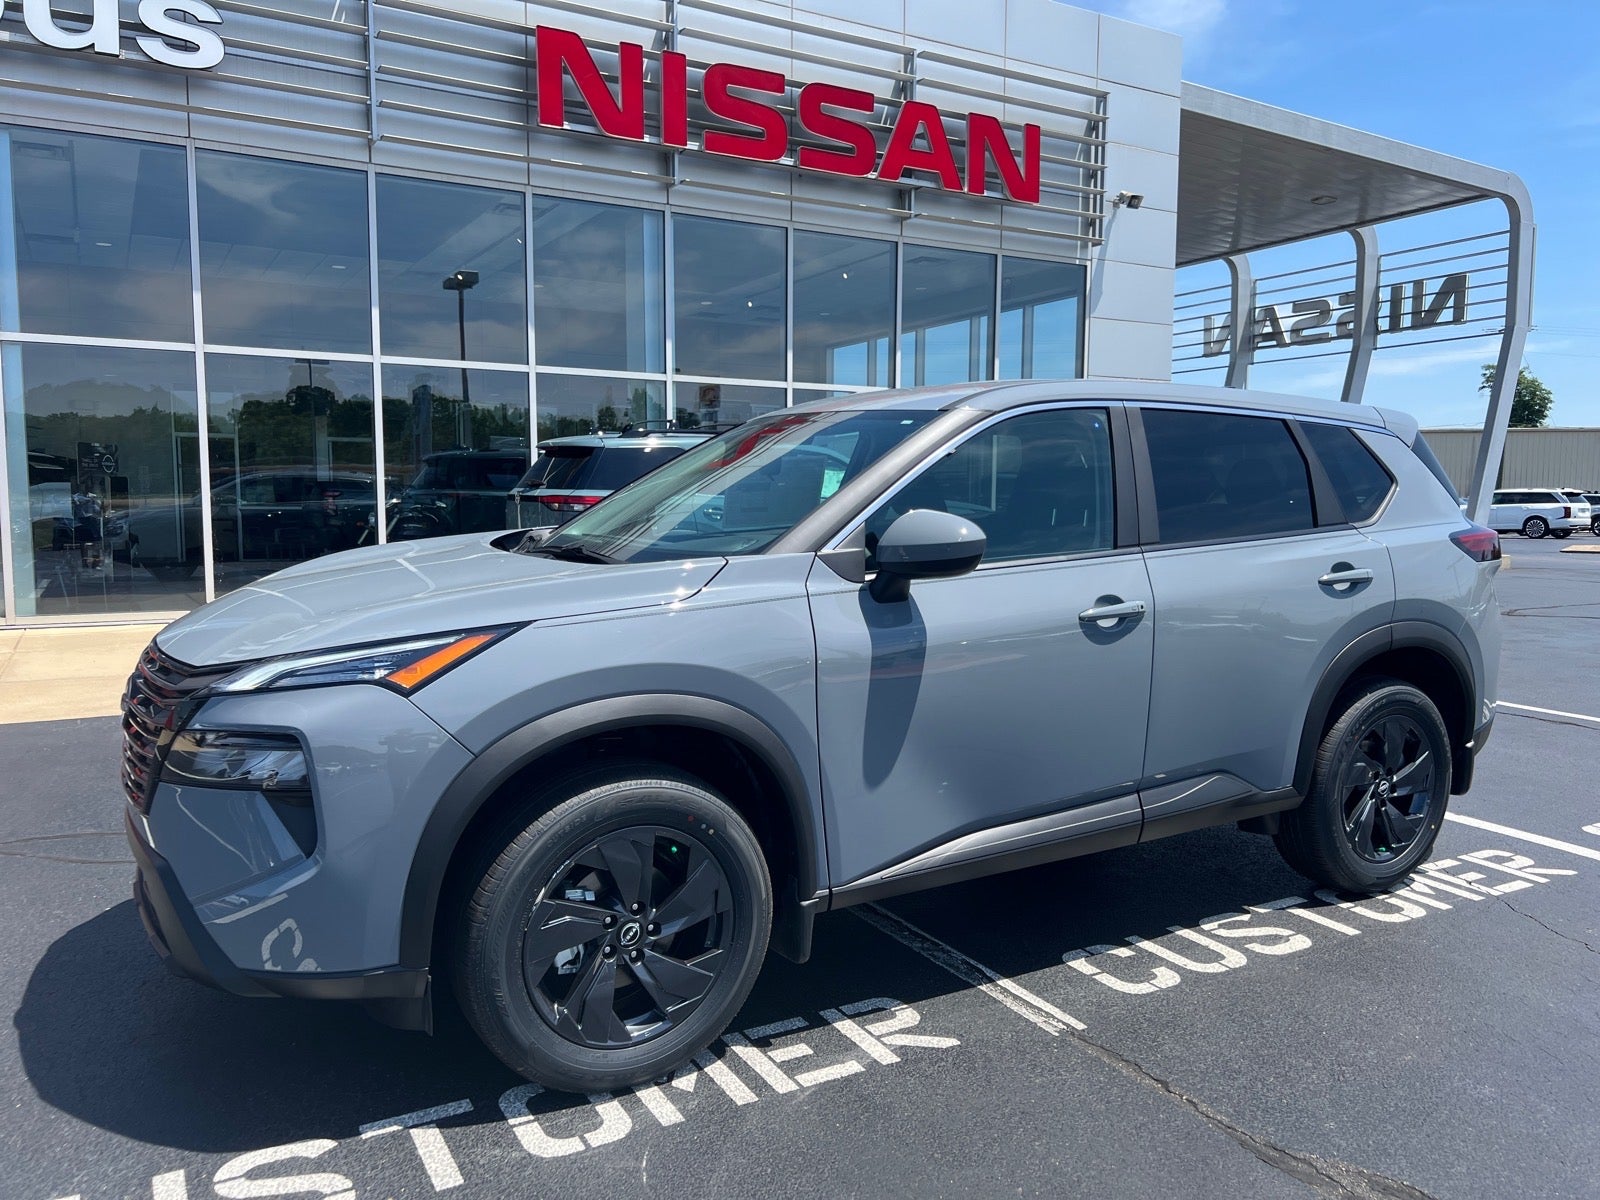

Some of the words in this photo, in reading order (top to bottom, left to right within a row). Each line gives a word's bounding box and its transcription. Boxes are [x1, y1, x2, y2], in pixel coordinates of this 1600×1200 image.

[0, 0, 225, 69] us
[535, 24, 1041, 204] NISSAN
[1062, 849, 1578, 995] CUSTOMER
